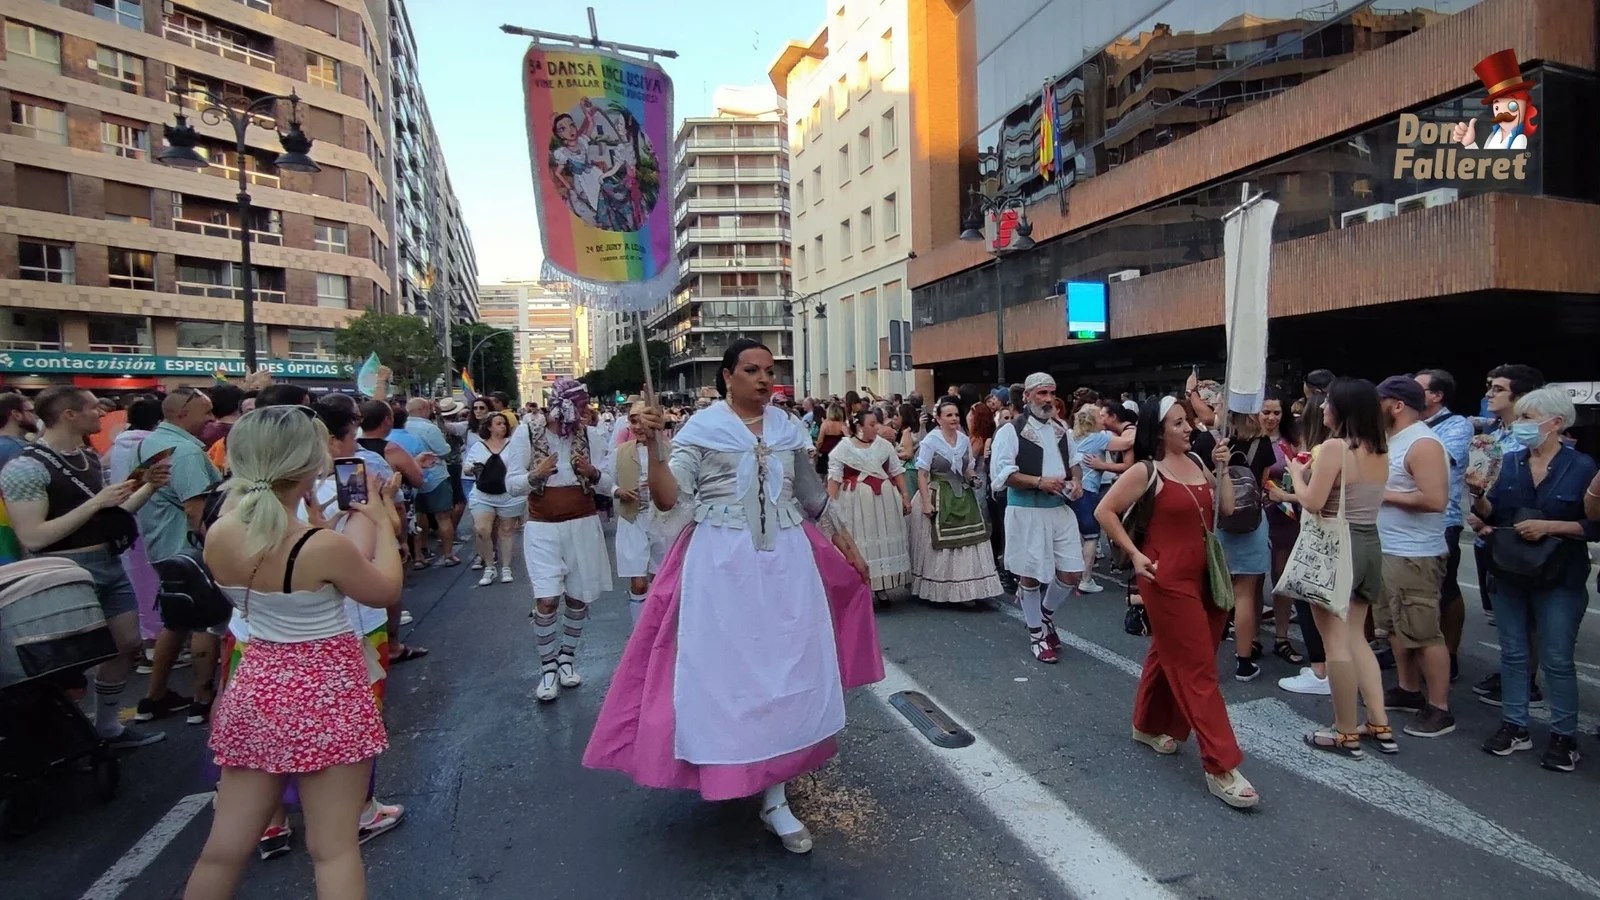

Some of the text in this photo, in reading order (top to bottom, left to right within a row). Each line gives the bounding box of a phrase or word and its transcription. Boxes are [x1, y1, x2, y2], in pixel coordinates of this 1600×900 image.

[557, 80, 564, 89] A
[566, 79, 600, 88] BALLAR
[601, 64, 662, 93] INCLUSIVA
[164, 359, 284, 374] ESPECIALIDES
[288, 360, 338, 375] ÓPTICAS
[34, 448, 64, 469] adidas
